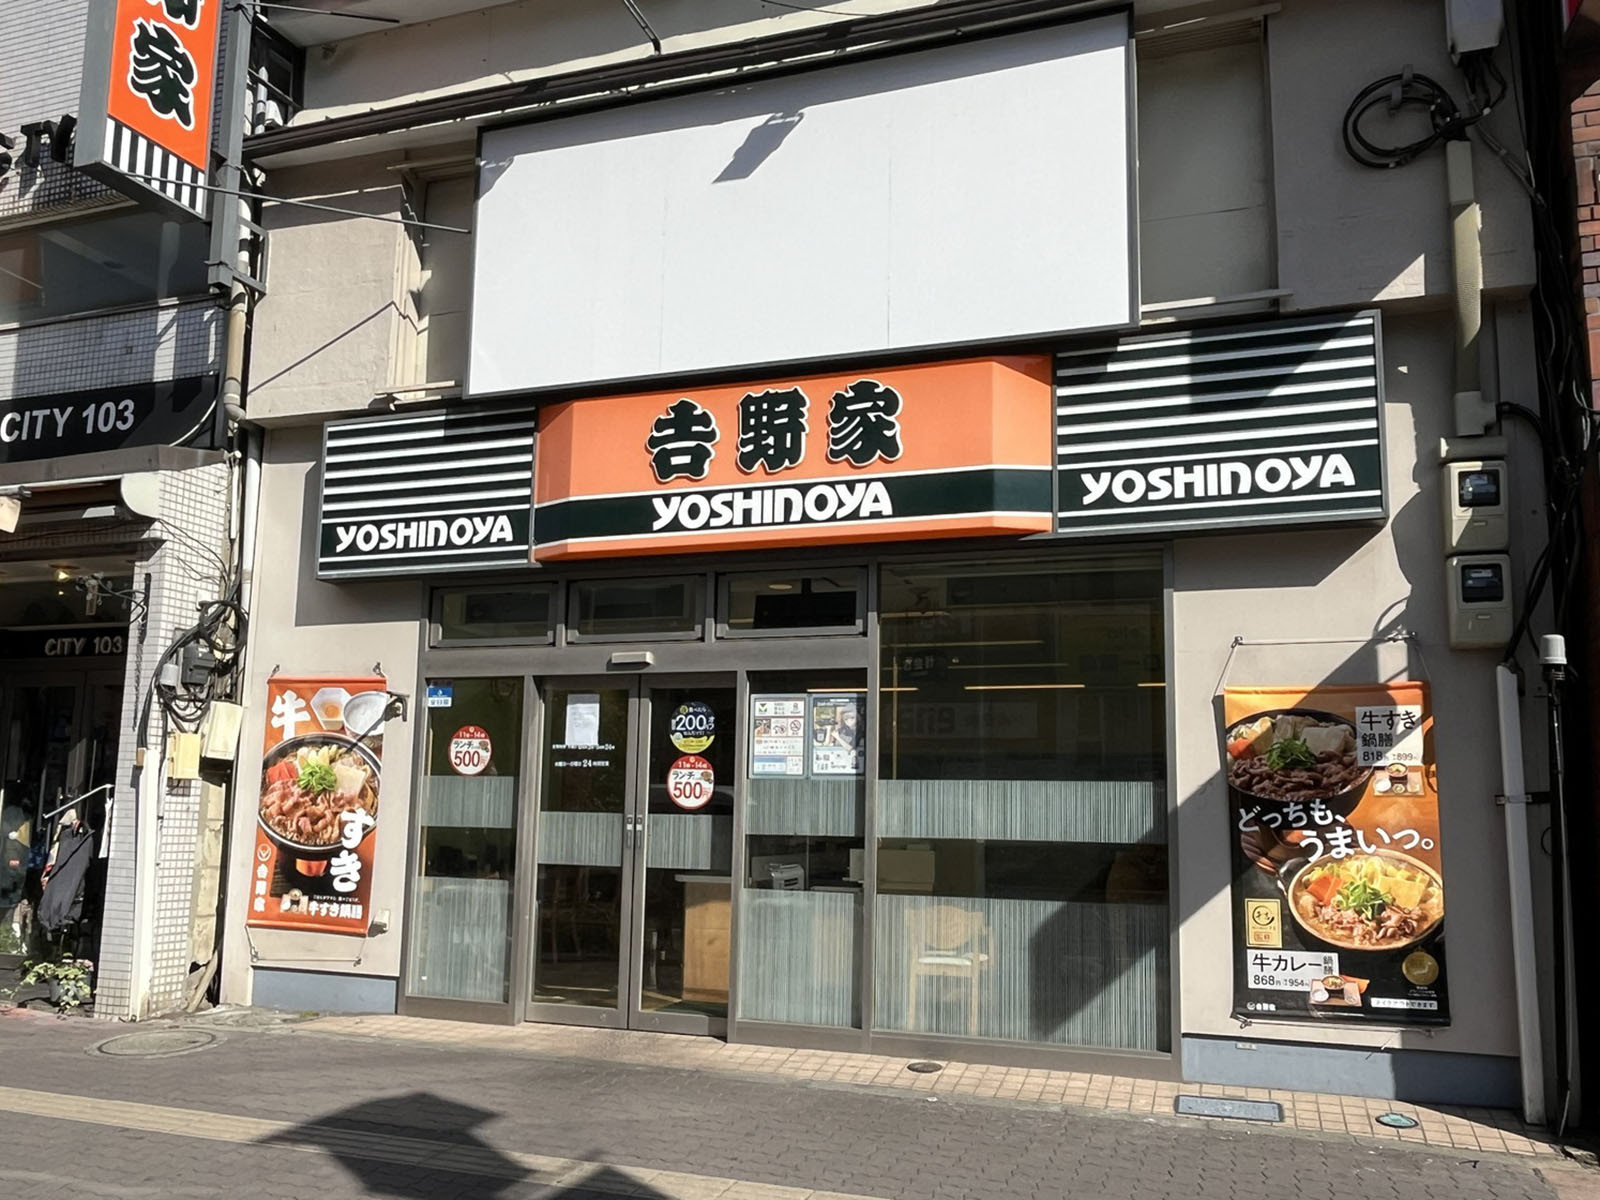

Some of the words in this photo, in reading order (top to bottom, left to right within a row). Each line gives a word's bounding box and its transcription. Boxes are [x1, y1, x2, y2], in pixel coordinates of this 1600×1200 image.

[127, 0, 202, 131] 家
[0, 405, 73, 442] CITY
[82, 399, 135, 434] 103
[646, 379, 903, 483] 吉野家
[1081, 453, 1356, 505] YOSHINOYA
[652, 481, 893, 532] YOSHINOYA
[336, 514, 513, 553] YOSHINOYA
[44, 638, 87, 656] CITY
[92, 635, 123, 654] 103
[271, 690, 311, 740] 牛
[1361, 709, 1417, 732] 牛すき
[330, 808, 375, 892] すき
[1252, 953, 1322, 973] 牛カレー
